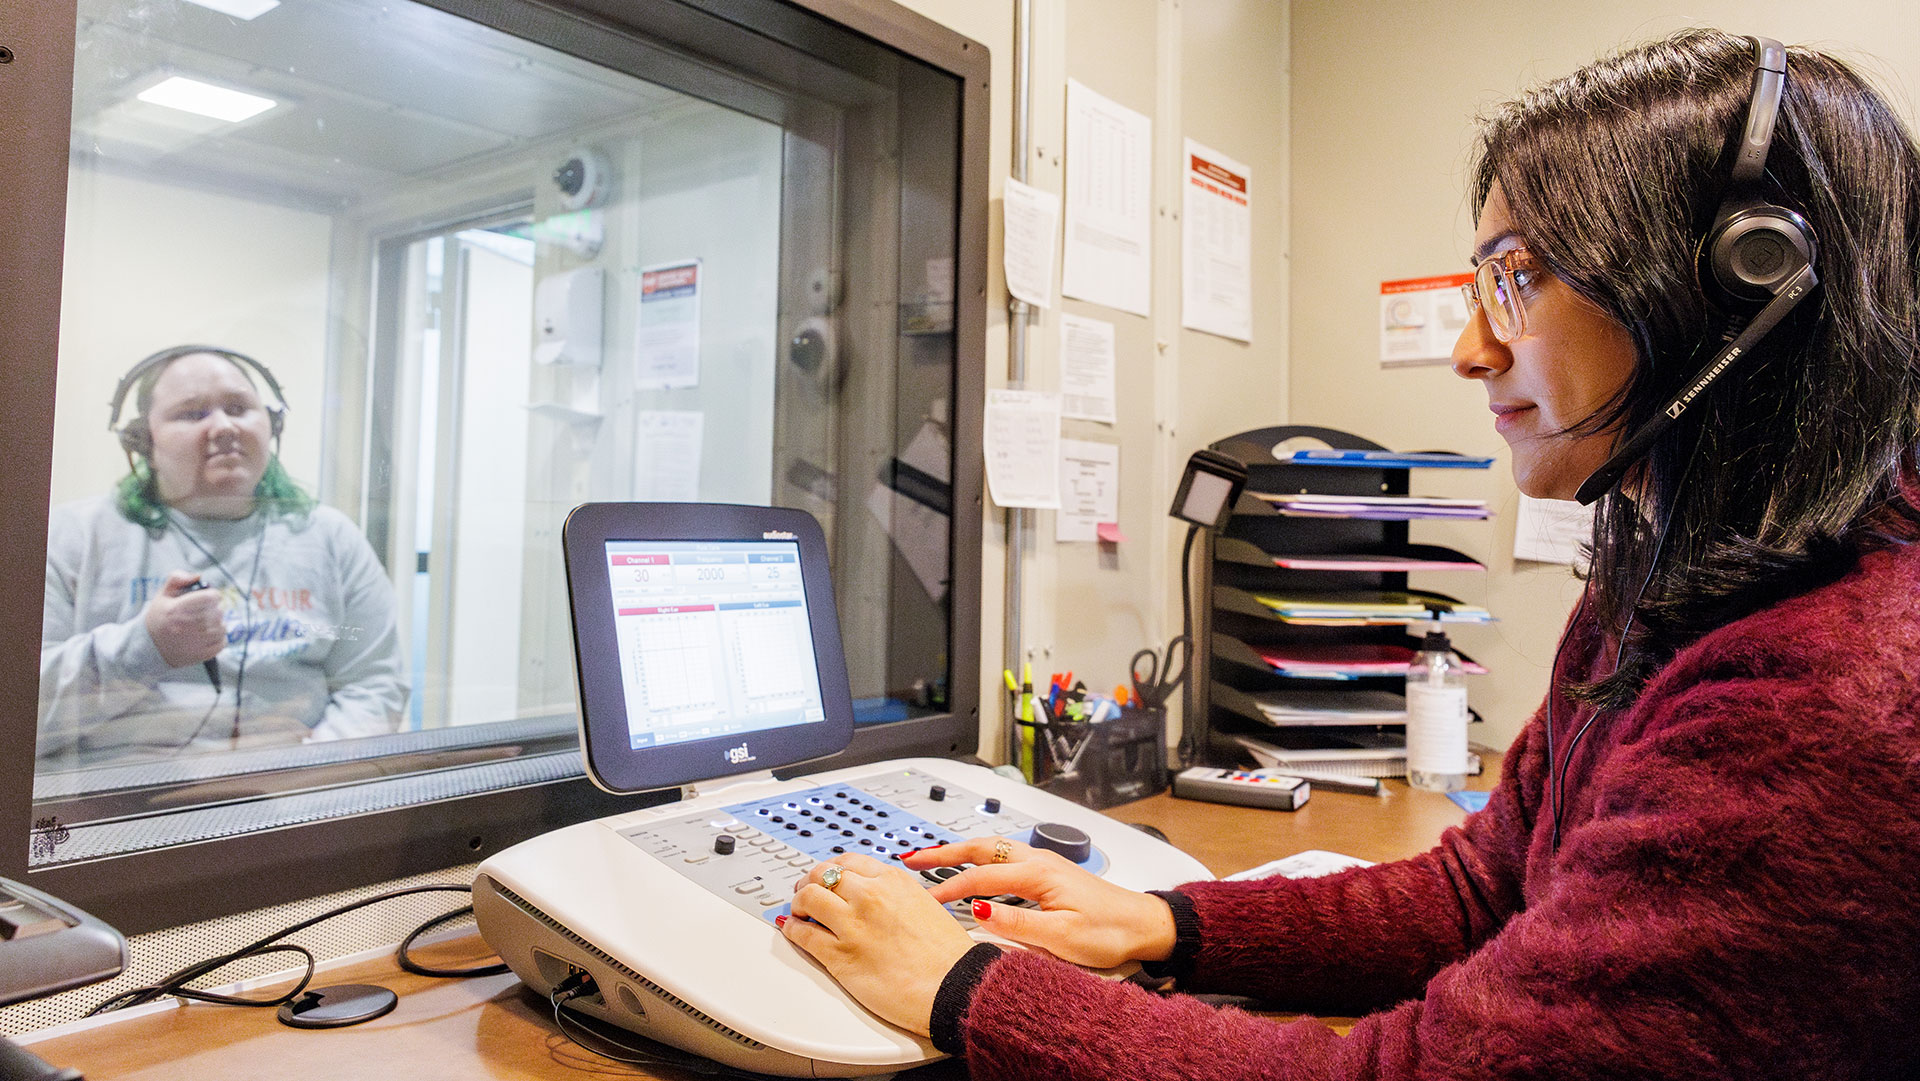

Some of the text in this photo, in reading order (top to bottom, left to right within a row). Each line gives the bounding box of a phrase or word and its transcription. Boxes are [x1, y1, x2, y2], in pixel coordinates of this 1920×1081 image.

[1787, 289, 1799, 300] PC
[1682, 346, 1742, 404] SENNHEISER
[633, 569, 650, 583] 30
[697, 568, 726, 581] 2000
[767, 566, 780, 579] 25
[729, 742, 750, 764] gsi
